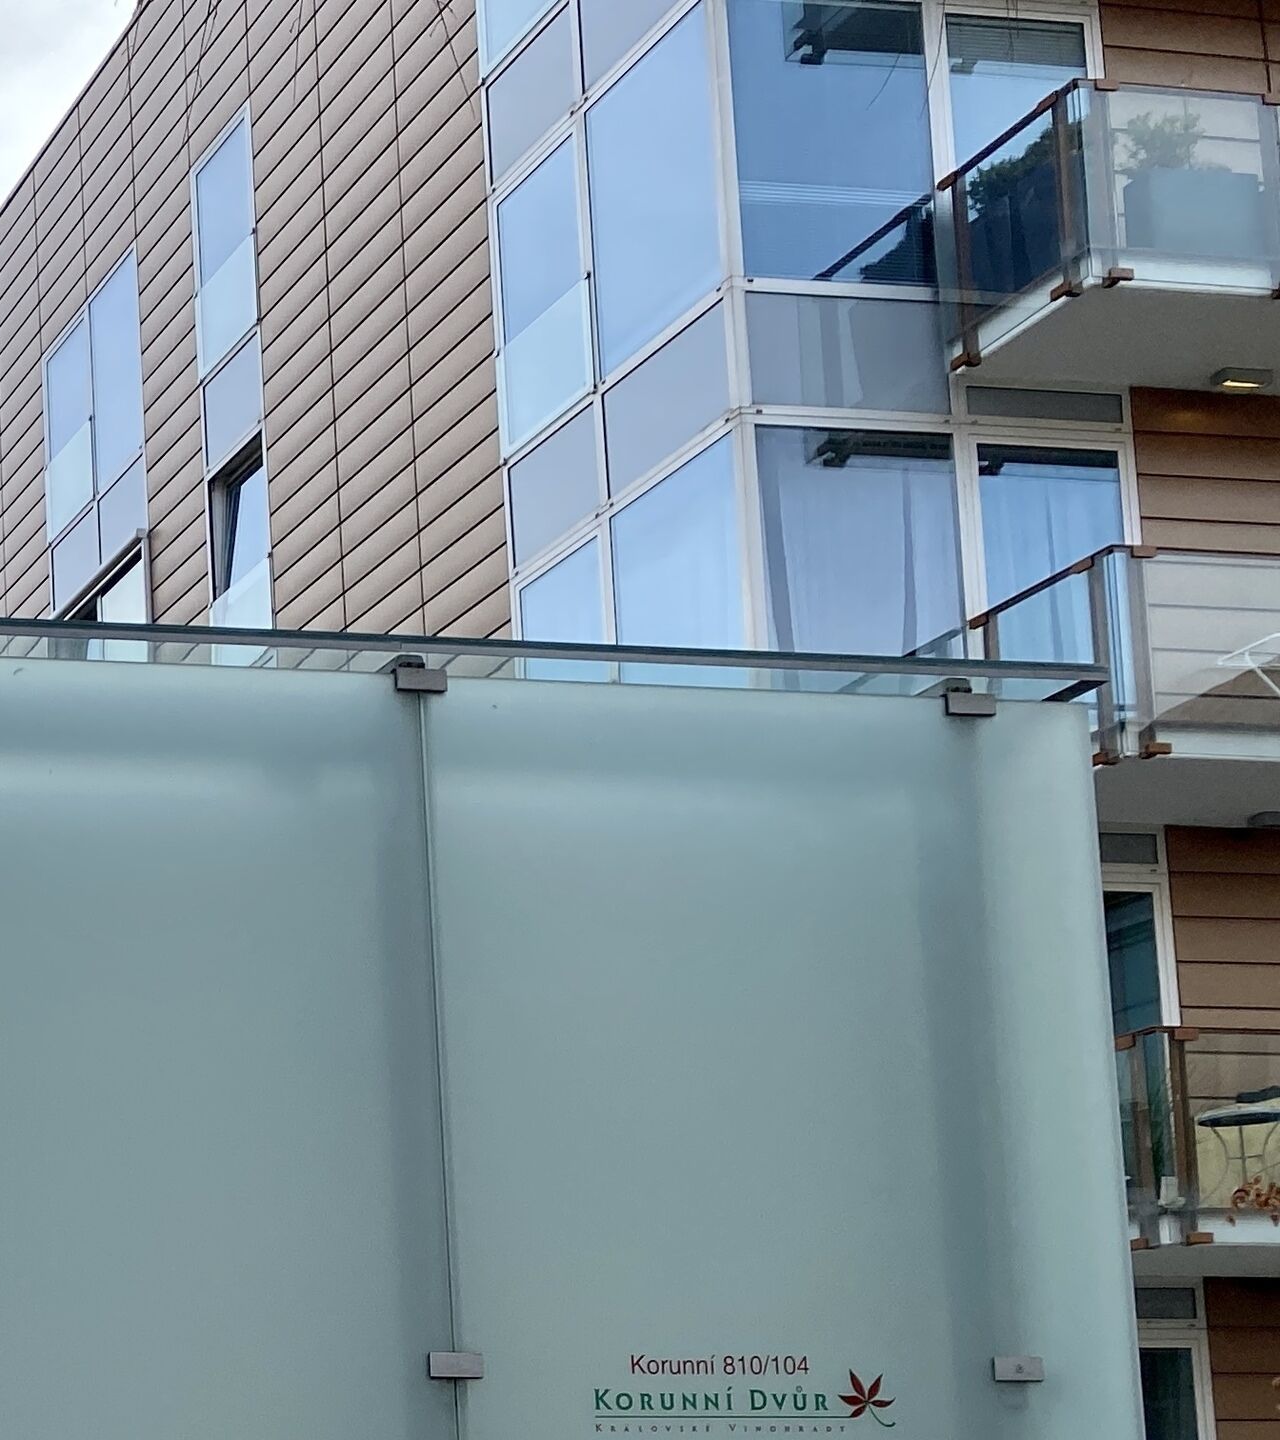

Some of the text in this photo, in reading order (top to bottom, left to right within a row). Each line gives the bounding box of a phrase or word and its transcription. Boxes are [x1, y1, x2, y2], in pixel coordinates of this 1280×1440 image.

[630, 1354, 810, 1376] Korunní 810/104
[594, 1385, 829, 1411] KORUNNÍ DVŮR
